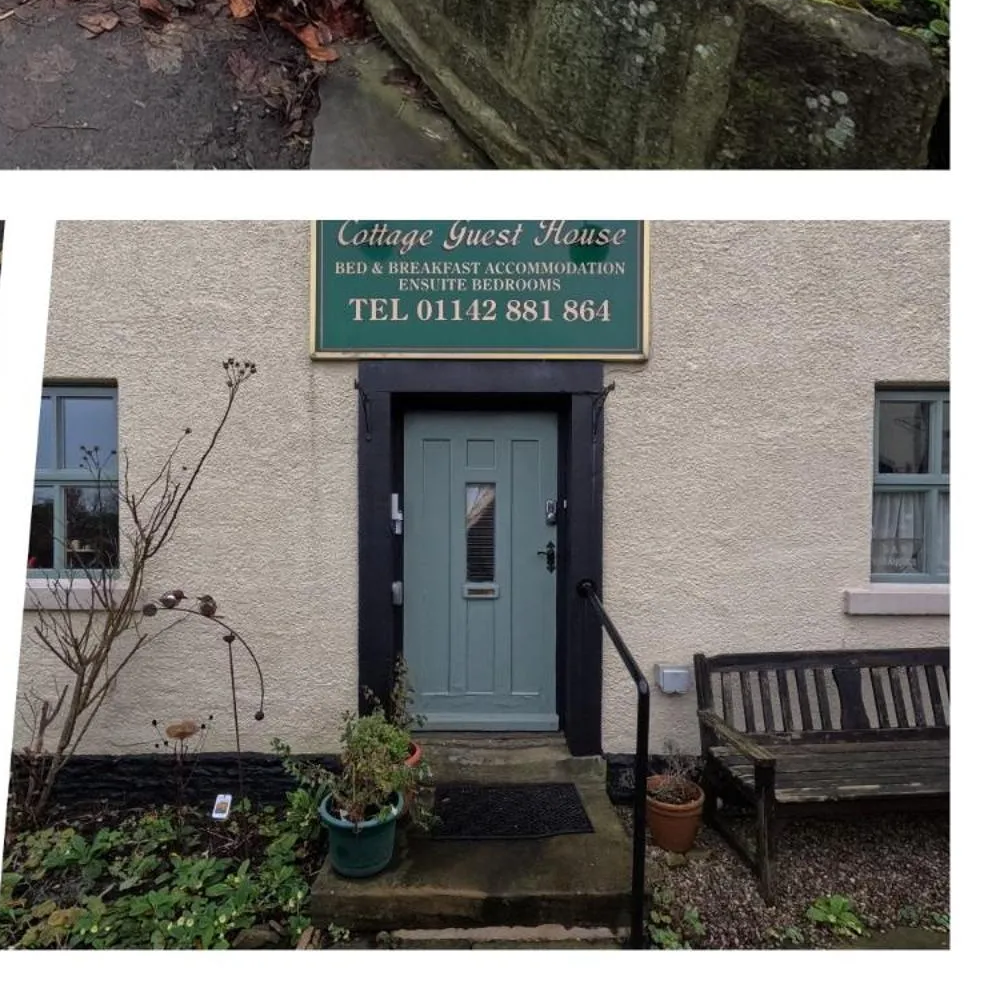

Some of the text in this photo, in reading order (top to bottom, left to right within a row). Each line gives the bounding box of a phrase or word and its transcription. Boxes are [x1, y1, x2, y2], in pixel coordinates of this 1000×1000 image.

[337, 220, 626, 255] Cottage Guest House
[335, 261, 626, 275] BED & BREAKFAST ACCOMMODATION
[399, 278, 561, 292] ENSUITE BEDROOMS
[349, 298, 611, 321] TEL 01142 881 864
